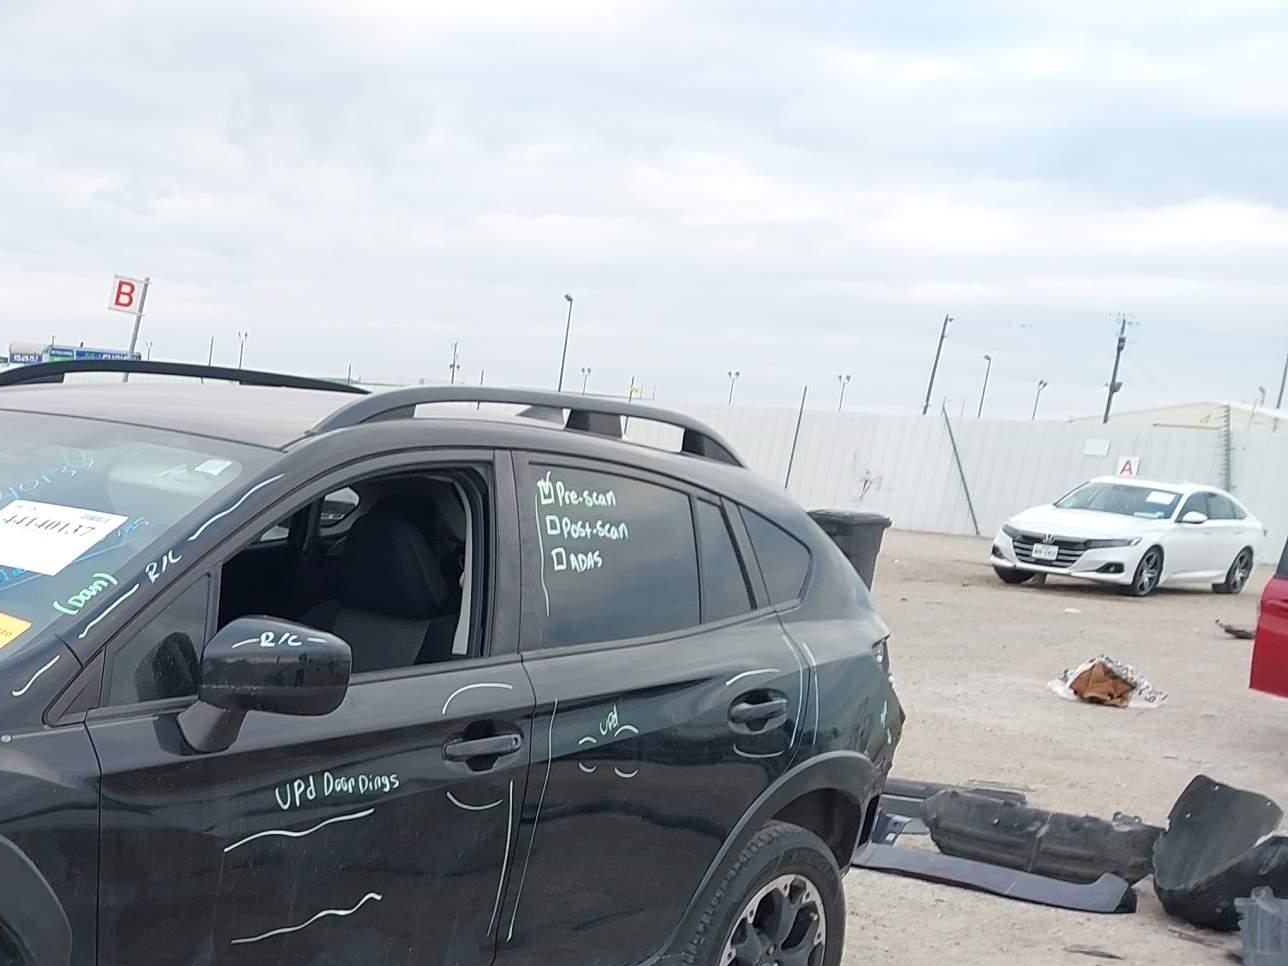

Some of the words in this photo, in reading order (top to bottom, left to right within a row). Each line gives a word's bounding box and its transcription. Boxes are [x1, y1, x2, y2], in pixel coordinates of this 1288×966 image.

[114, 279, 135, 307] B
[1119, 459, 1133, 475] A
[145, 550, 182, 584] R/C
[569, 549, 604, 573] ADAS
[259, 631, 303, 648] R/C
[323, 771, 355, 796] Door
[358, 774, 400, 795] Dings
